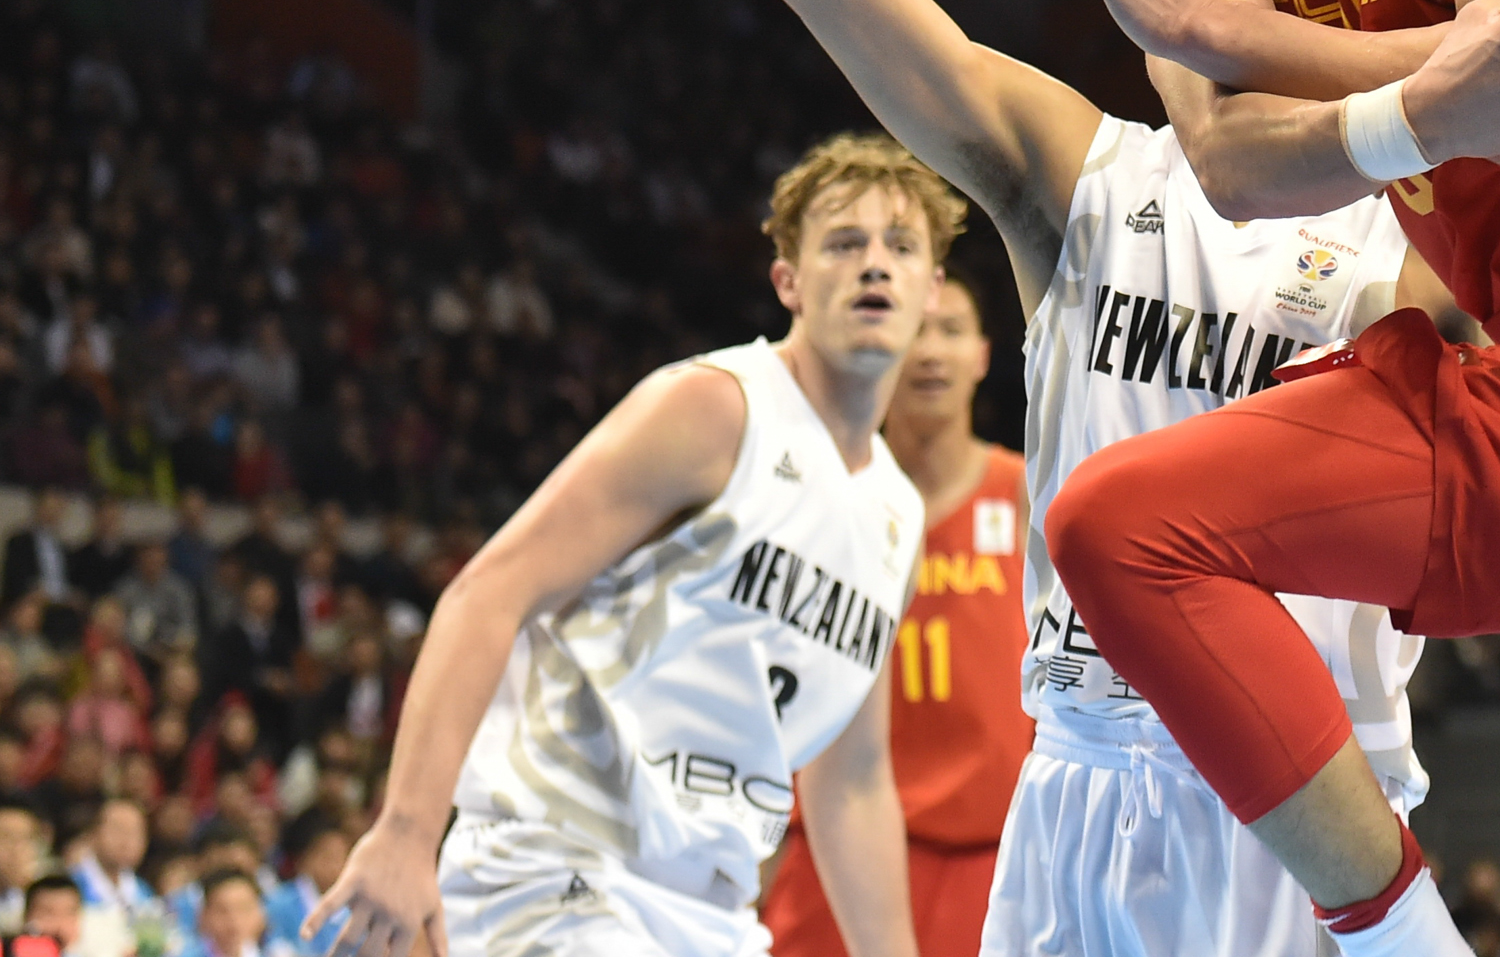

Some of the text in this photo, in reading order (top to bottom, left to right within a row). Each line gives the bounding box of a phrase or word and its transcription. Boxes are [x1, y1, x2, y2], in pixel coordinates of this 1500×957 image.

[1275, 291, 1326, 310] WORLD CUP
[898, 616, 951, 702] 11
